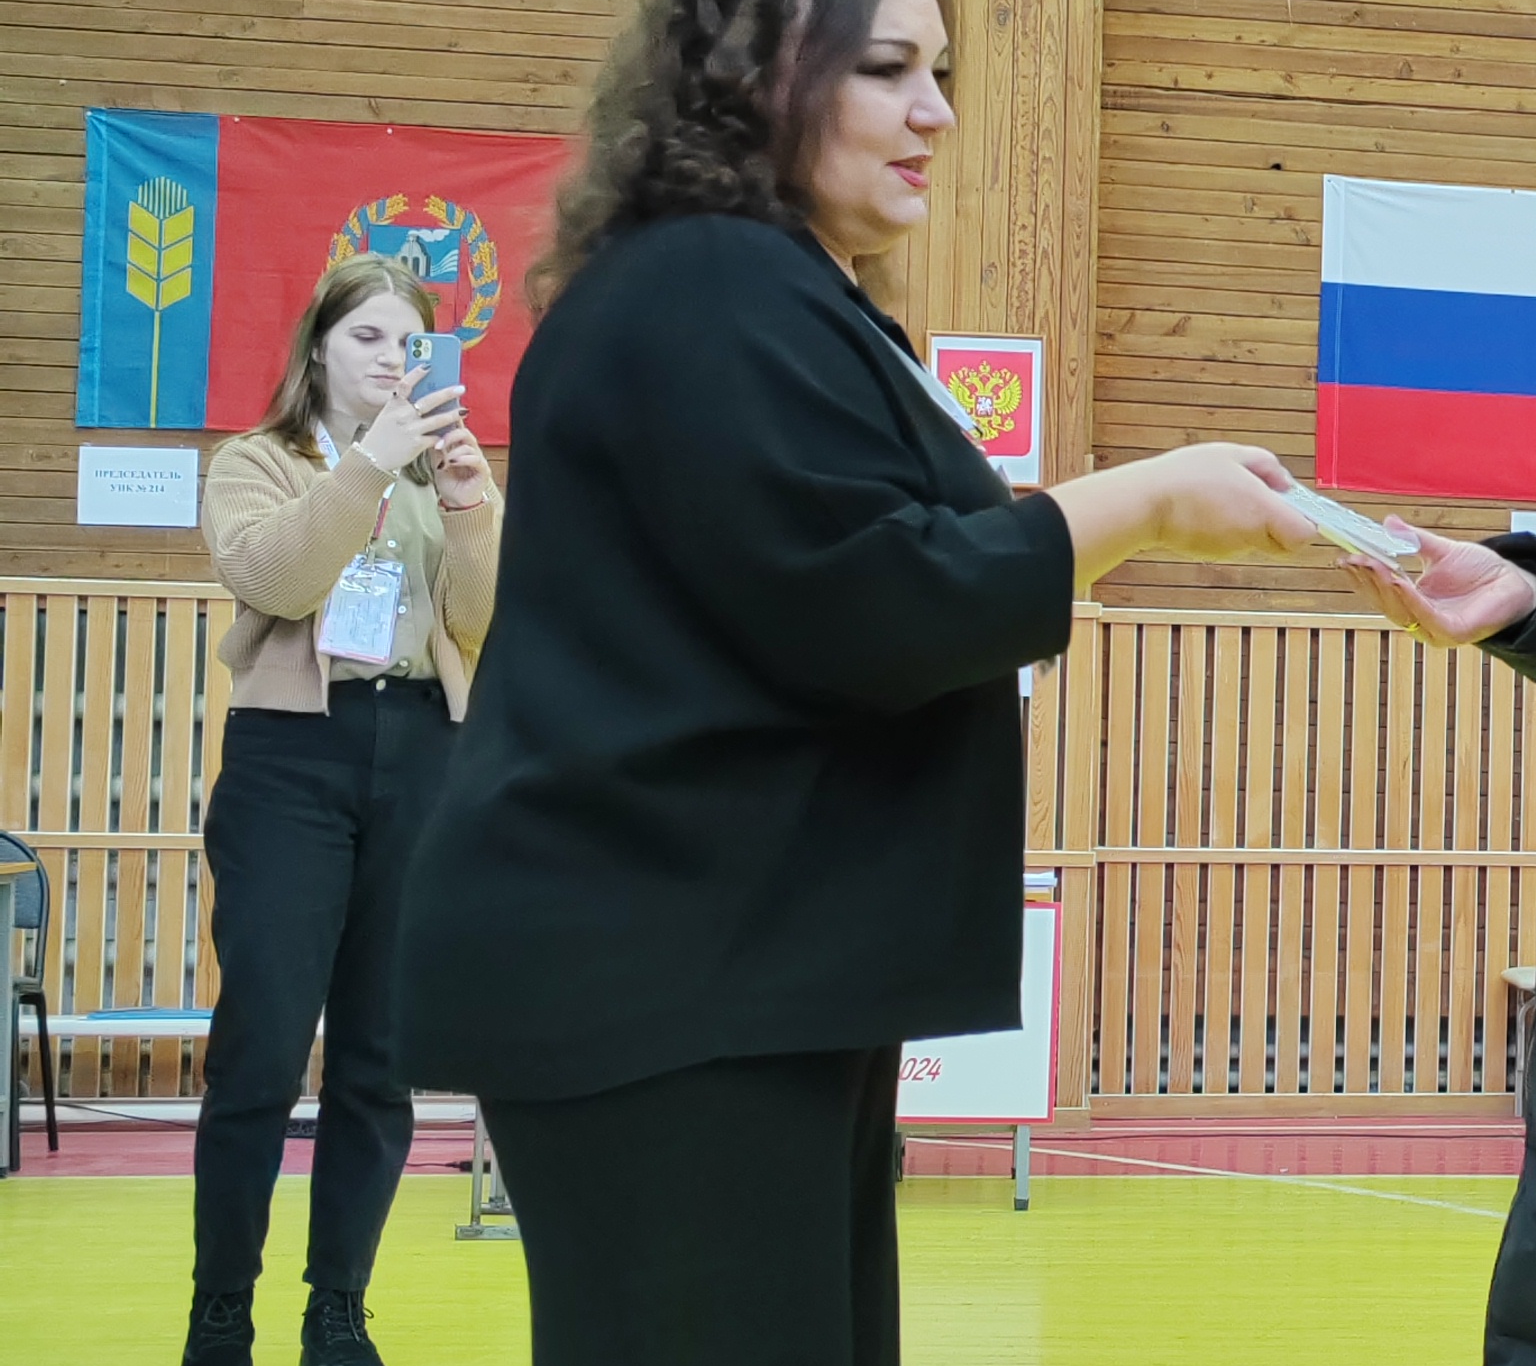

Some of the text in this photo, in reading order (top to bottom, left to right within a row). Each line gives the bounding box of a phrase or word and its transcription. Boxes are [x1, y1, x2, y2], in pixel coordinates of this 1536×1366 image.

[94, 469, 182, 480] ПРЕДСЕДАТЕЛЬ
[110, 484, 134, 493] УИК
[149, 484, 165, 493] 214
[898, 1057, 942, 1081] 024
